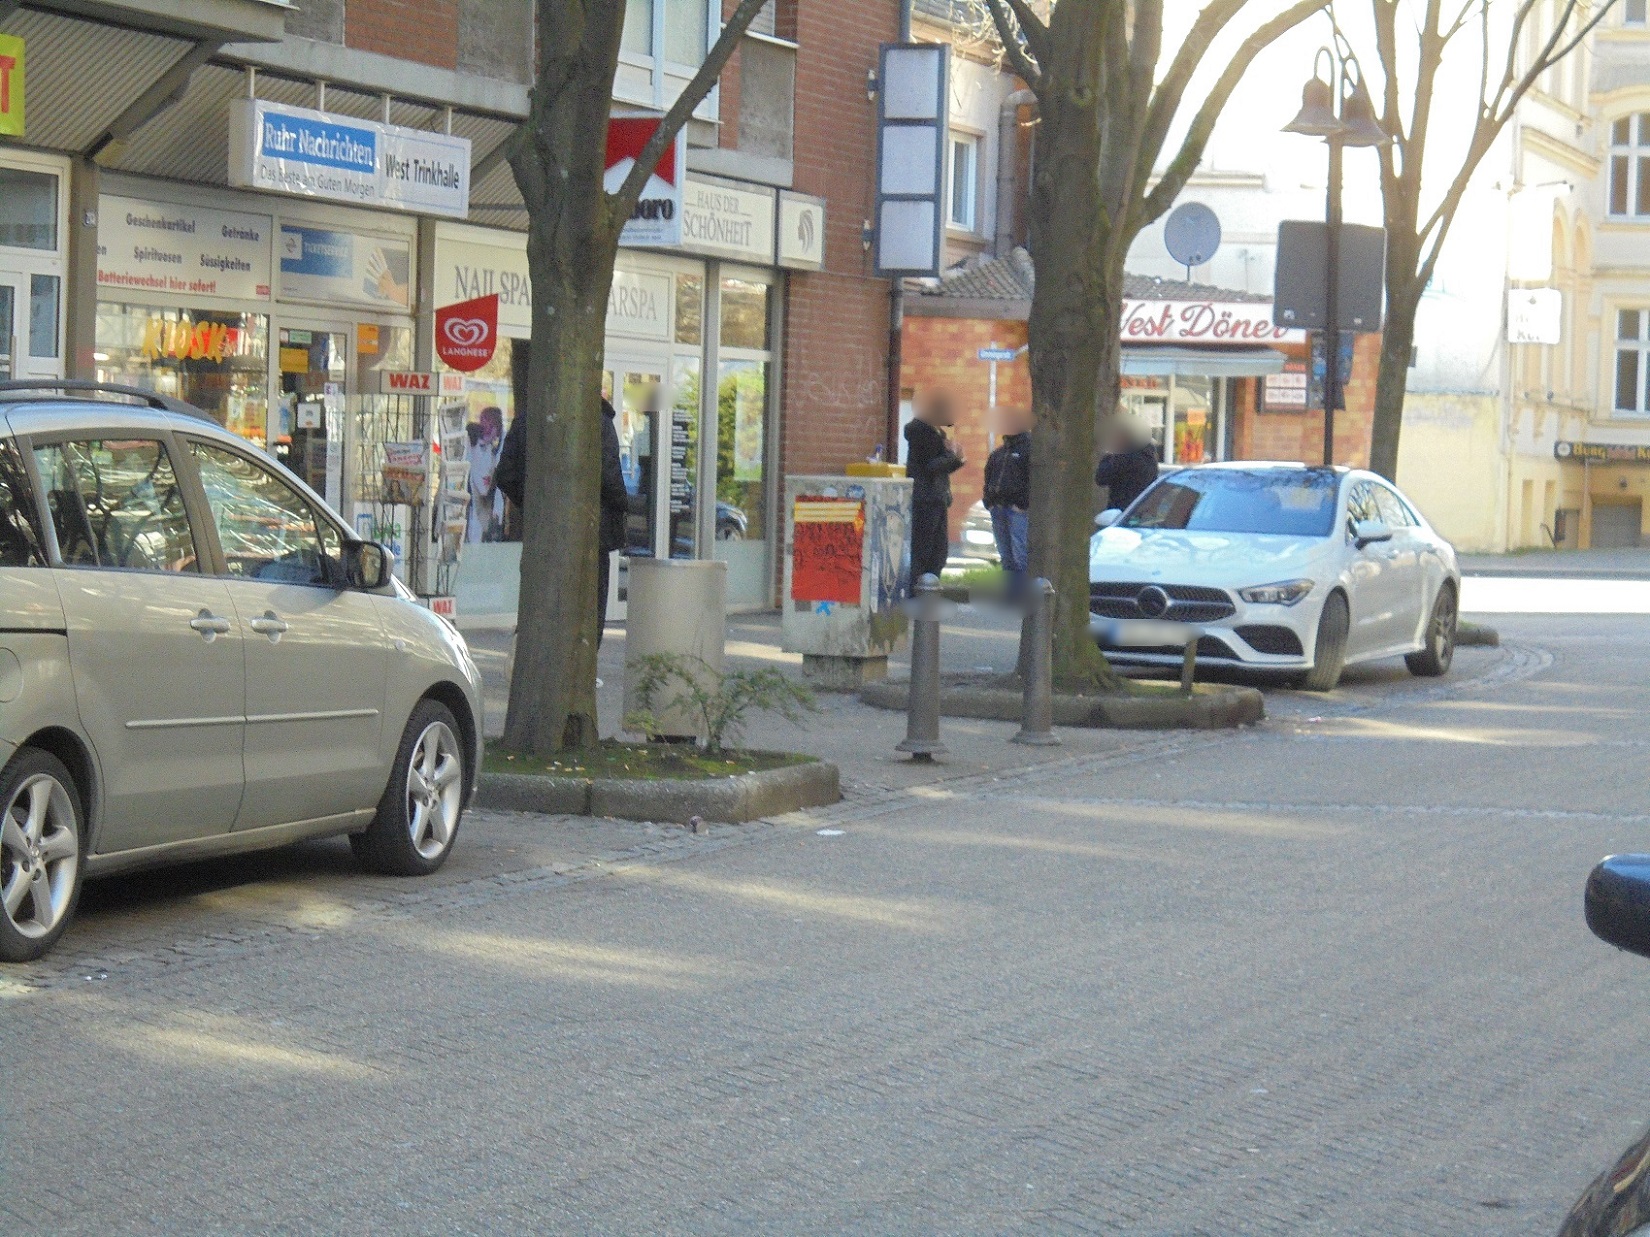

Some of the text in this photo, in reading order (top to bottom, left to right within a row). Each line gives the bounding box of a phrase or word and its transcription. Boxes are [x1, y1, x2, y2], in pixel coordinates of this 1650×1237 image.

[263, 123, 297, 152] Ruhr
[261, 164, 276, 181] Das
[317, 174, 342, 192] Guten
[344, 177, 375, 199] Morgen
[385, 153, 460, 189] West Trinkhalle
[698, 190, 740, 215] HAUS DER
[126, 212, 196, 233] Geschenkartikel
[683, 213, 753, 247] SCHÖNHEIT
[134, 246, 182, 264] Spirituosen
[98, 269, 216, 293] Batteriewechsel hier sofort!
[1179, 302, 1288, 338] Döner
[142, 319, 227, 364] KIOSK
[442, 346, 488, 357] LANGNESE
[389, 373, 462, 391] WAZ WAZ
[433, 599, 452, 614] WAZ
